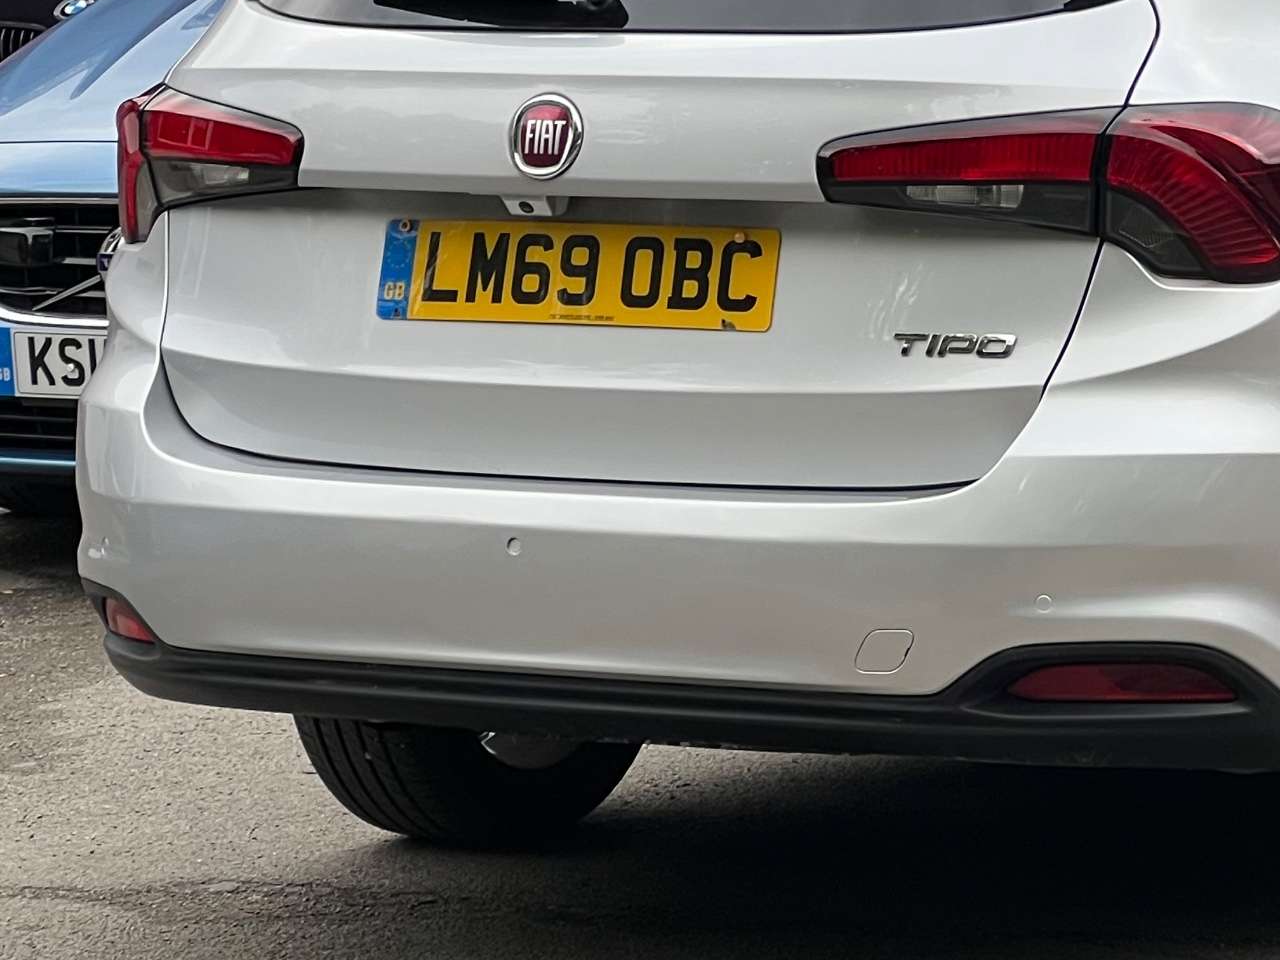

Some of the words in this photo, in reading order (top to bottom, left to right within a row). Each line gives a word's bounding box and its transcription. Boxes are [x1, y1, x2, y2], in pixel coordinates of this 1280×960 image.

[524, 119, 567, 155] FIAT
[421, 230, 601, 307] LM69
[619, 235, 763, 313] OBC
[384, 282, 405, 300] GB
[894, 332, 1017, 359] TIPO
